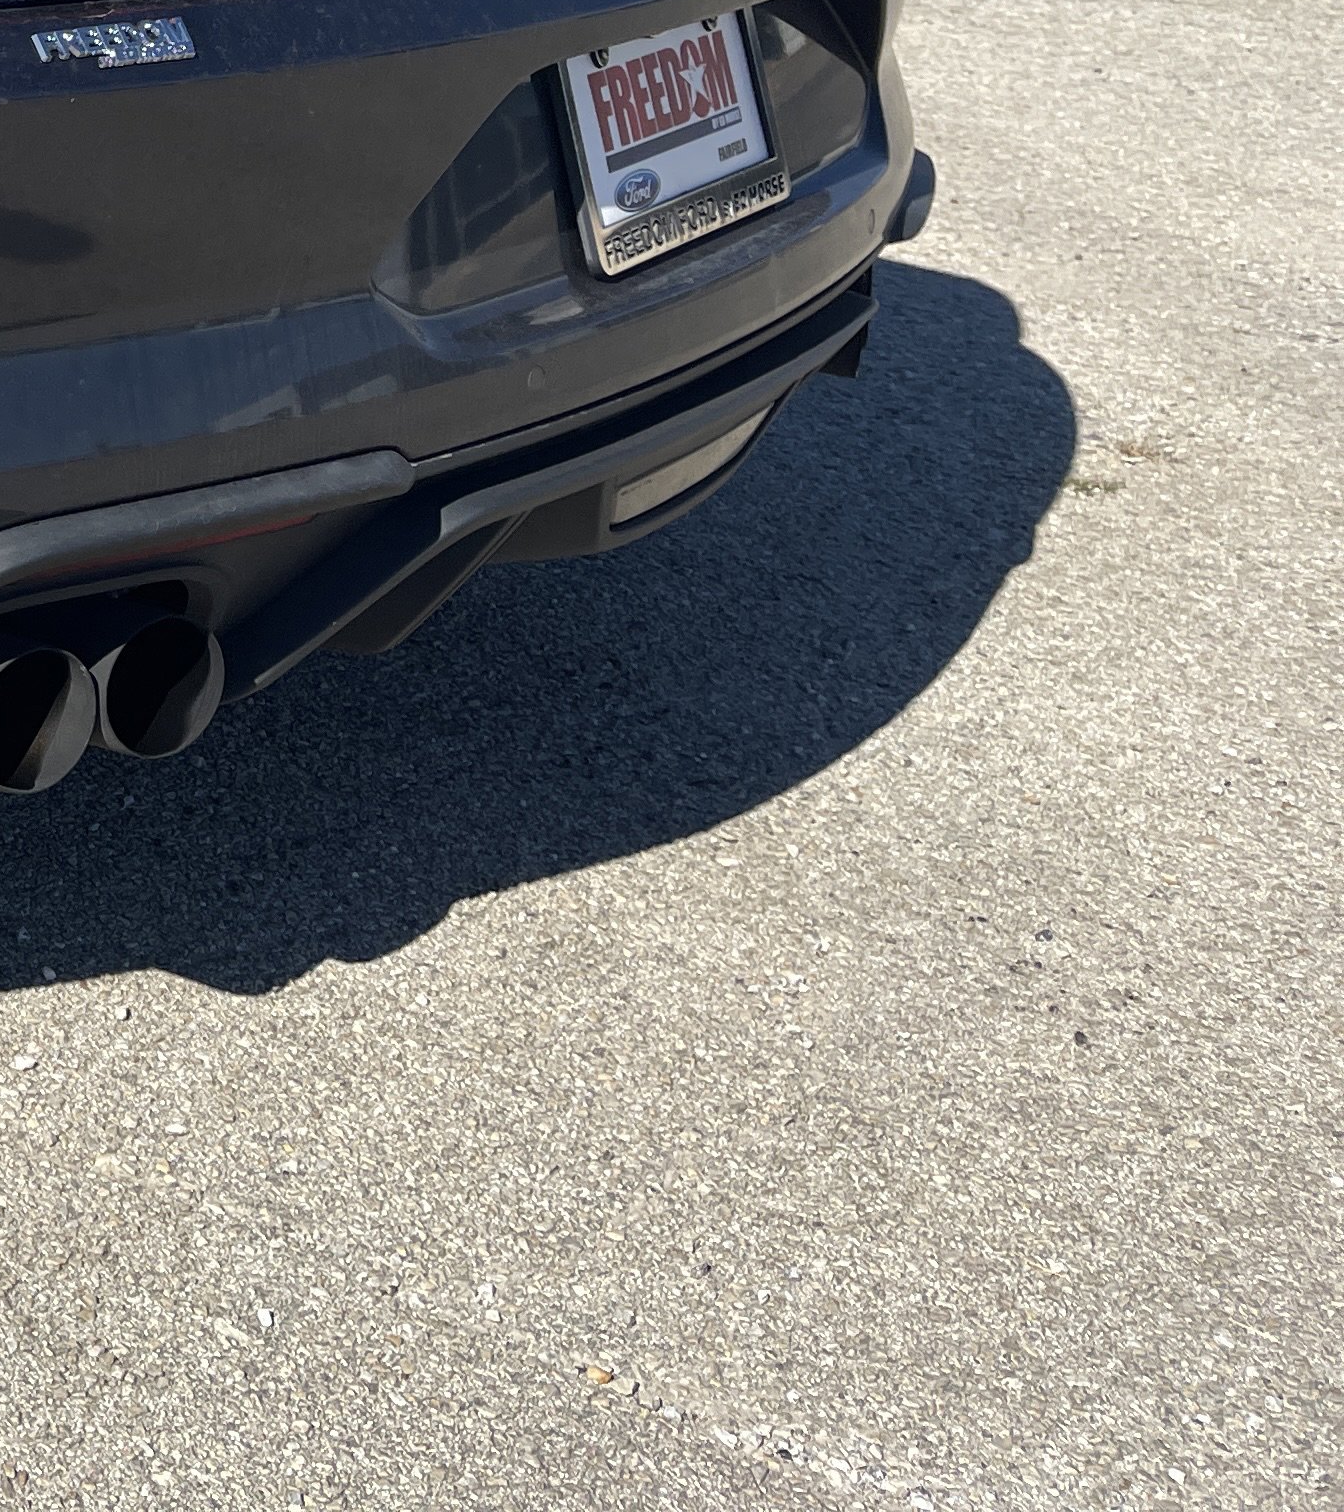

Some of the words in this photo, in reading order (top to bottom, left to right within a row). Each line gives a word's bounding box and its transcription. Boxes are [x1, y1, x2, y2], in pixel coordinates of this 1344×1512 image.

[587, 30, 738, 154] FREEDOM
[603, 212, 680, 269] FREEDOM
[678, 197, 719, 237] FORD
[748, 173, 785, 205] MORSE
